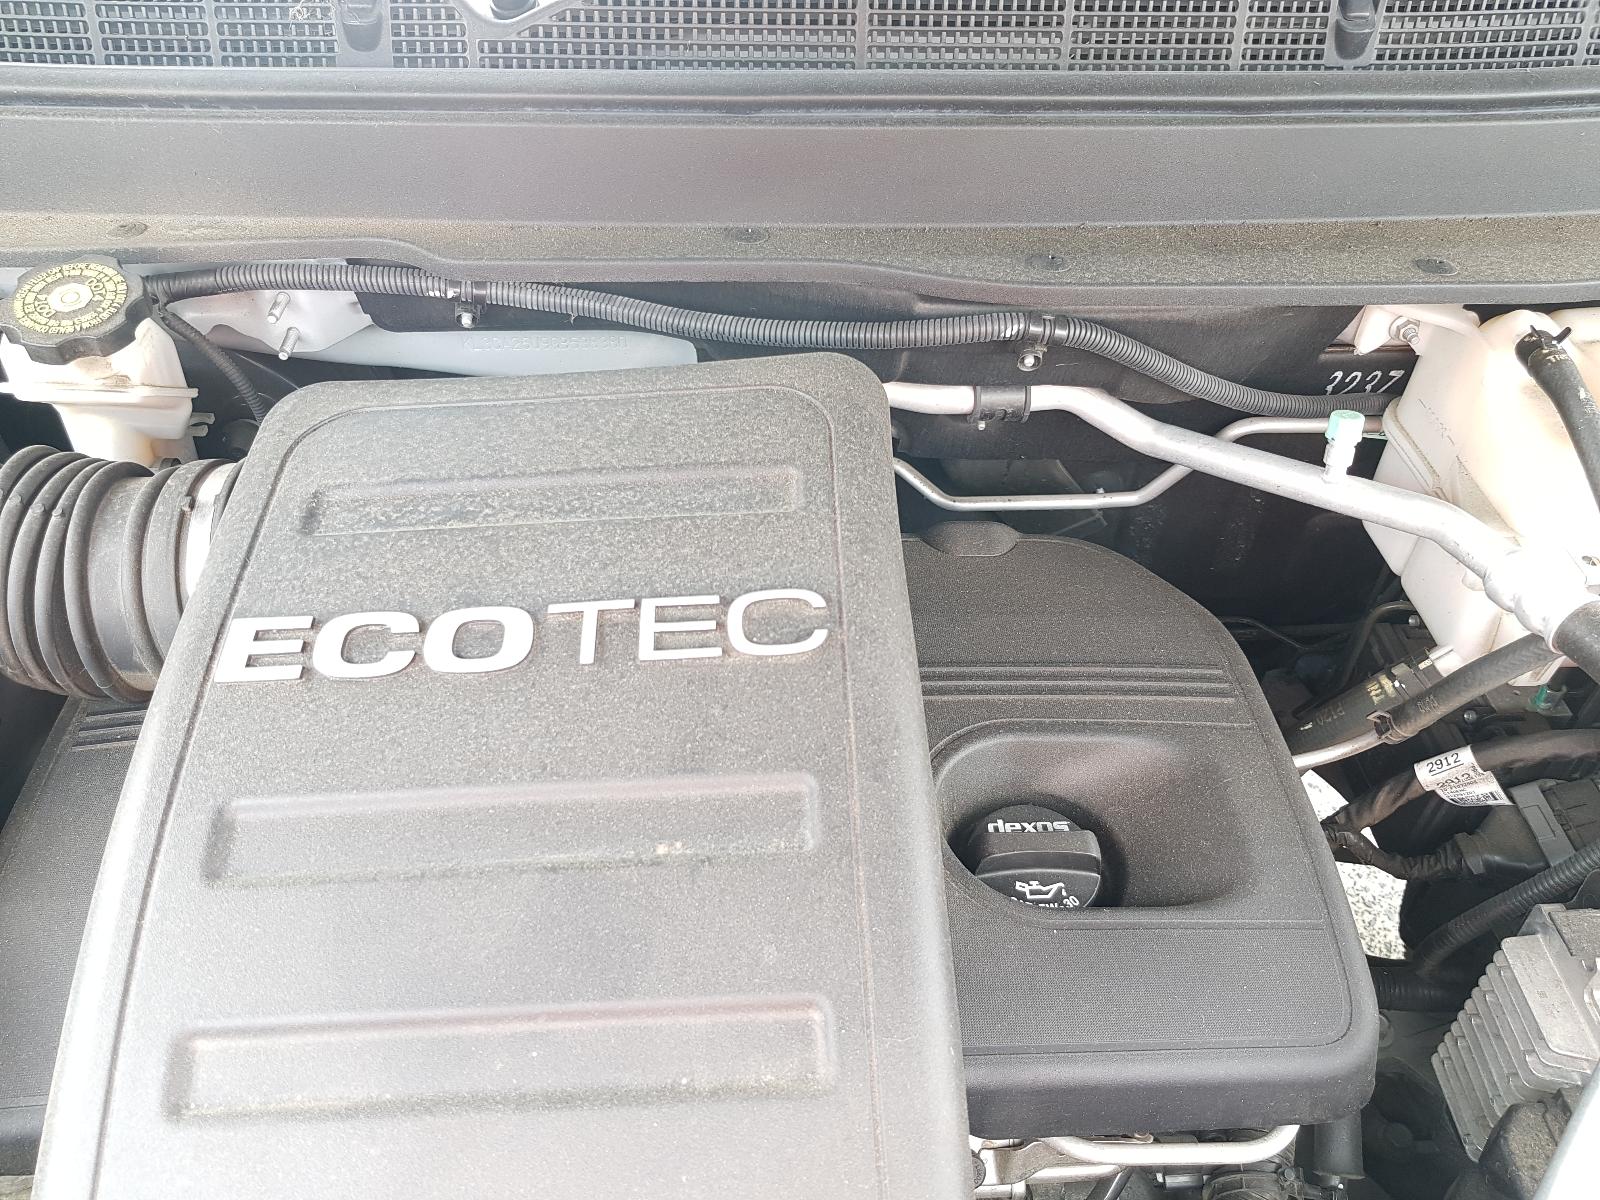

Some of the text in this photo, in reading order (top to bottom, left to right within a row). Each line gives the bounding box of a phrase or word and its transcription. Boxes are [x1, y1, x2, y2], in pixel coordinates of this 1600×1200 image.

[213, 587, 829, 683] ECOTEC
[1426, 752, 1462, 774] 2912
[987, 818, 1070, 833] dexos
